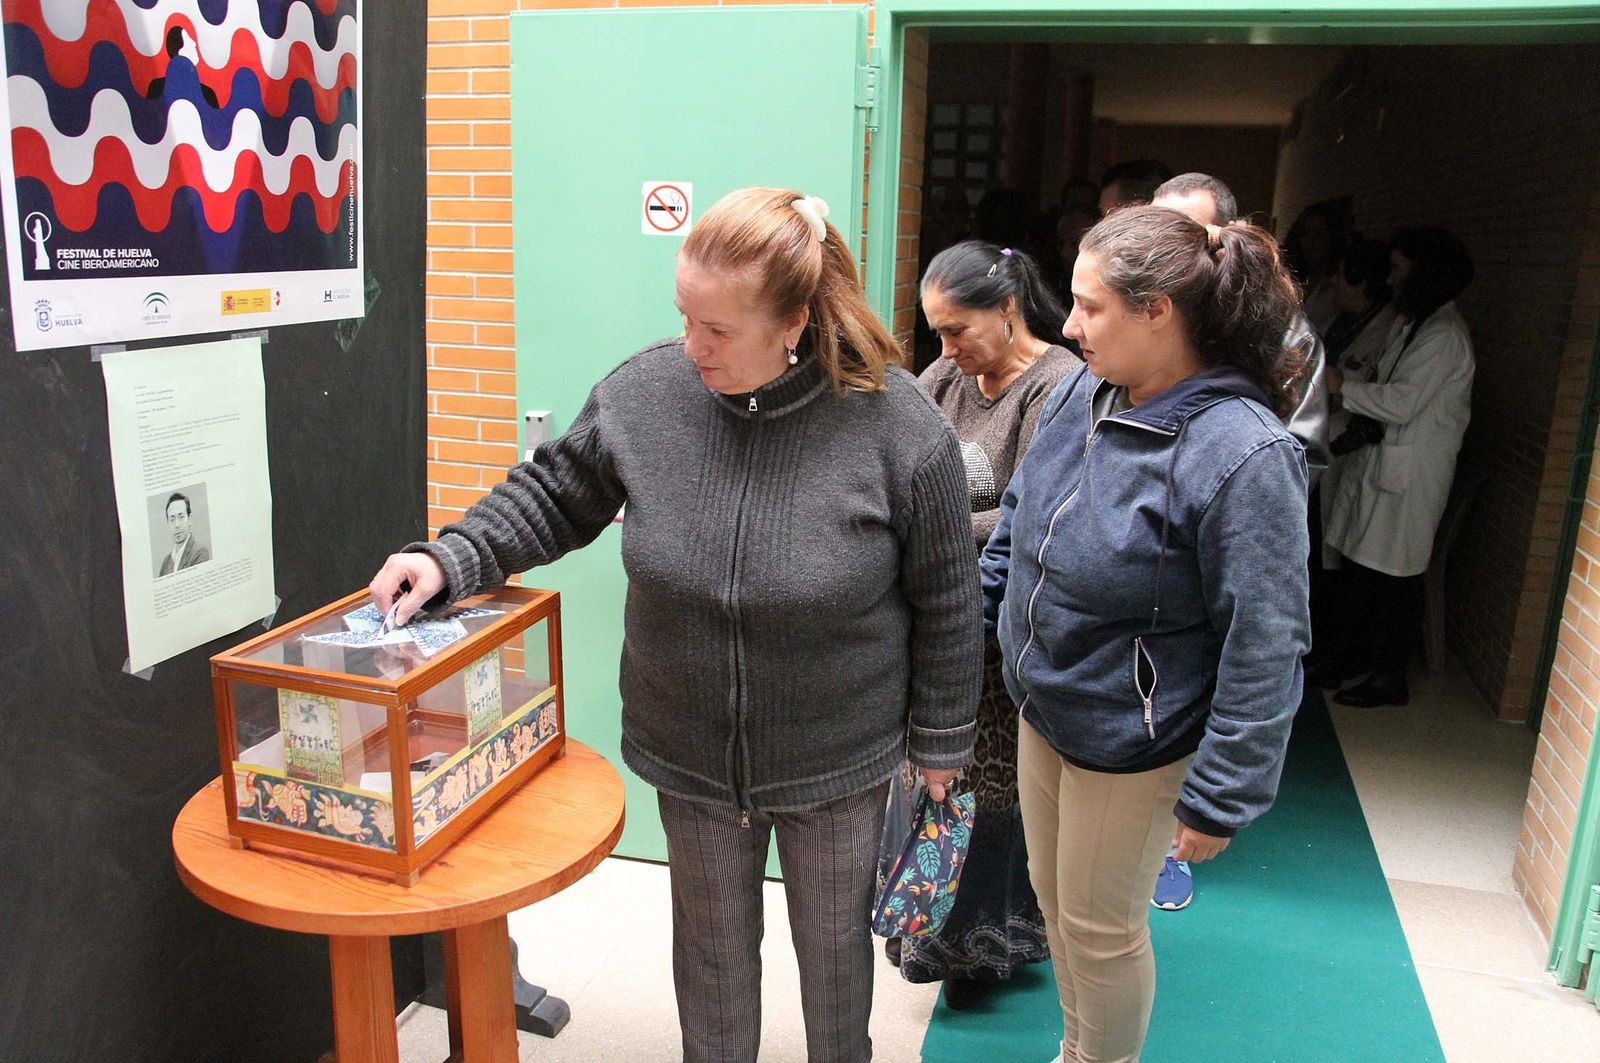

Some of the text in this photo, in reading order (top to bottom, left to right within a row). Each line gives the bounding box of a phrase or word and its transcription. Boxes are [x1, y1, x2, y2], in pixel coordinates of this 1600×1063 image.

[56, 248, 152, 259] FESTIVAL DE HUELVA
[57, 258, 160, 270] CINE IBEROAMERICANO
[55, 318, 83, 327] HUELVA
